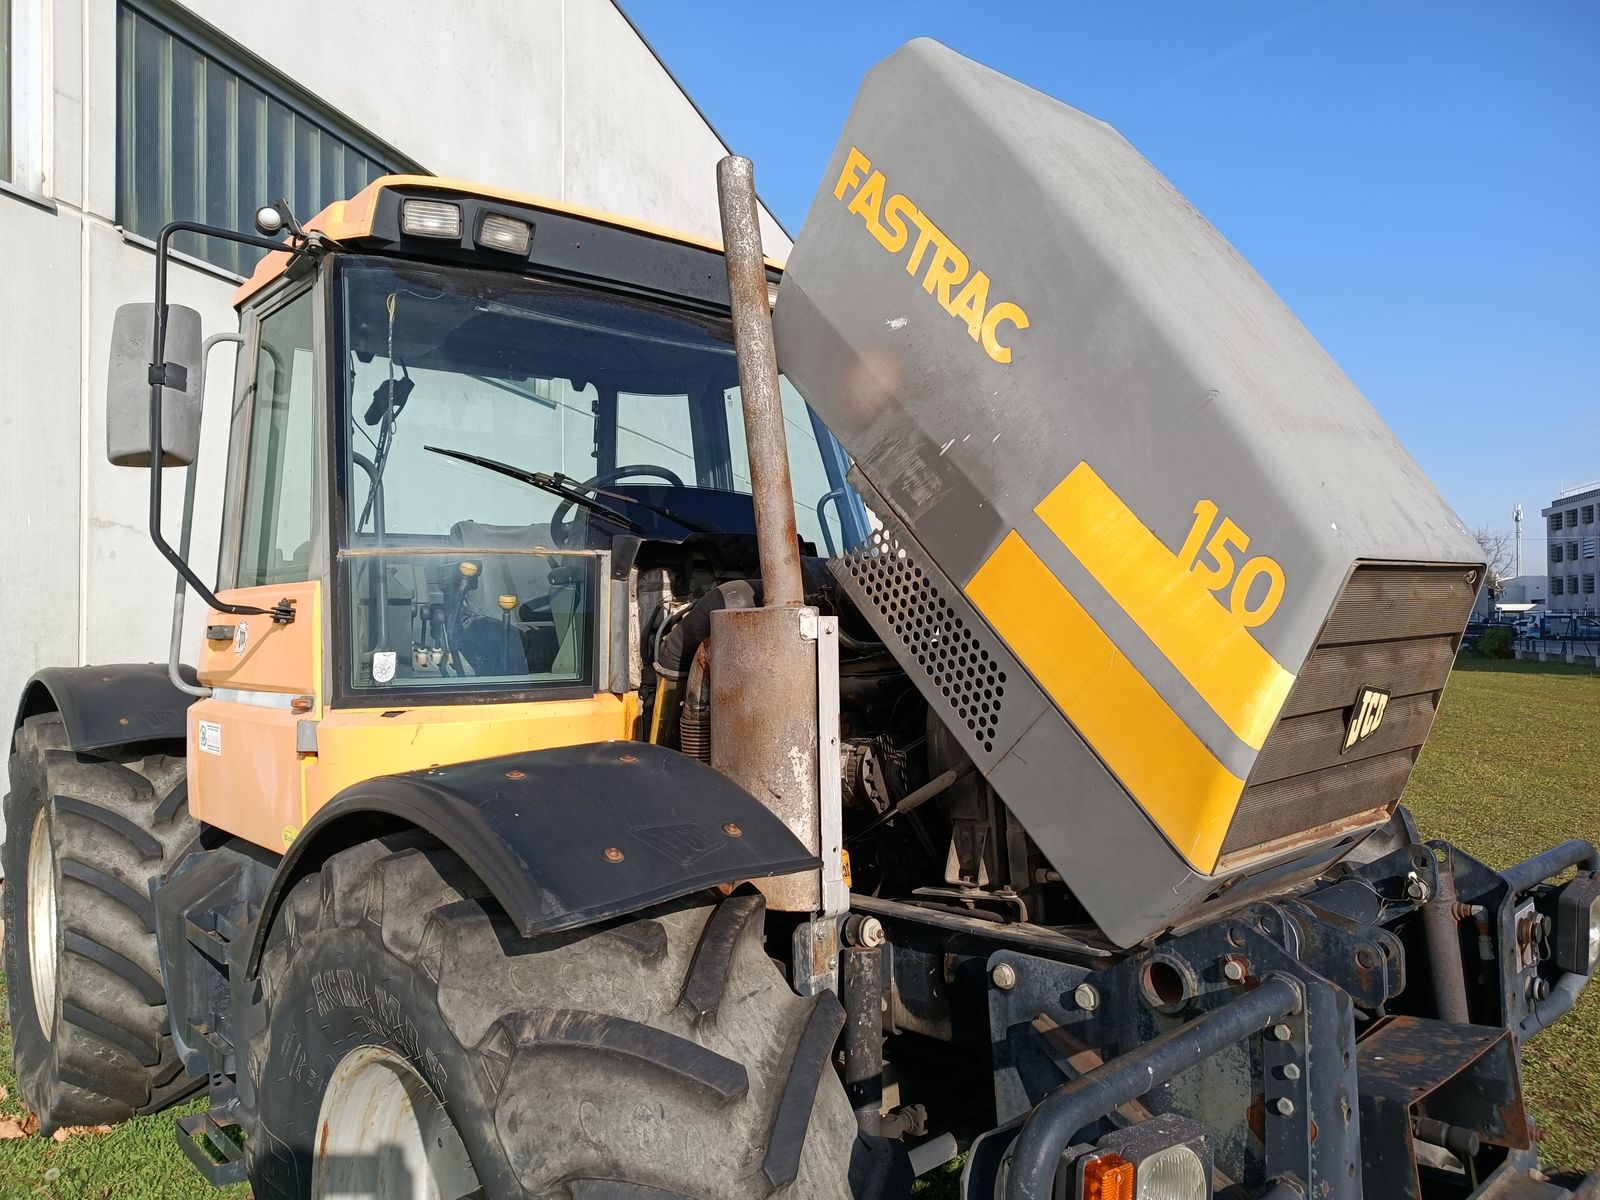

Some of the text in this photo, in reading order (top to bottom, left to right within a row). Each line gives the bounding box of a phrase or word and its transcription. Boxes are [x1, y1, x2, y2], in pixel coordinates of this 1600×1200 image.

[833, 145, 1030, 364] FASTRAC
[1177, 499, 1286, 628] 150
[1345, 690, 1389, 749] JCB
